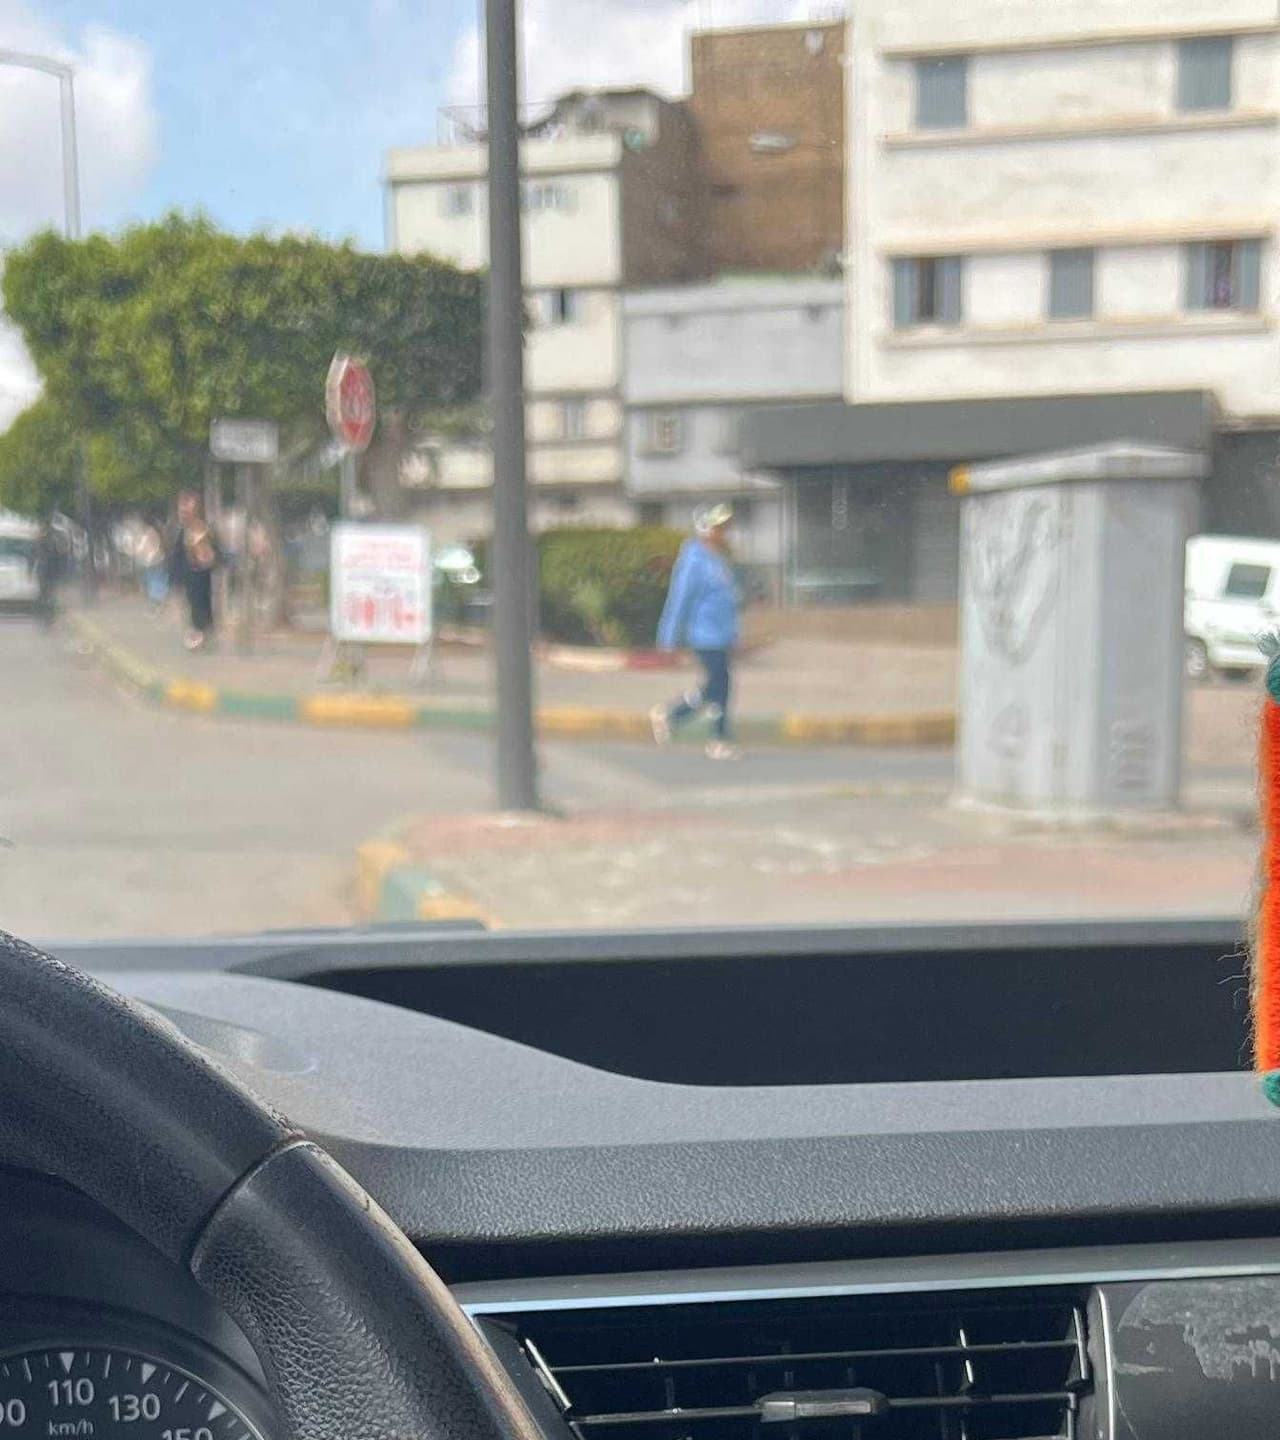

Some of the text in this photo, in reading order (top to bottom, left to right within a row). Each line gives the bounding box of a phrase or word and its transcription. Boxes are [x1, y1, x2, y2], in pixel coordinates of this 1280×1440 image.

[48, 1378, 95, 1406] 110
[108, 1393, 161, 1422] 130
[48, 1419, 94, 1436] km/h
